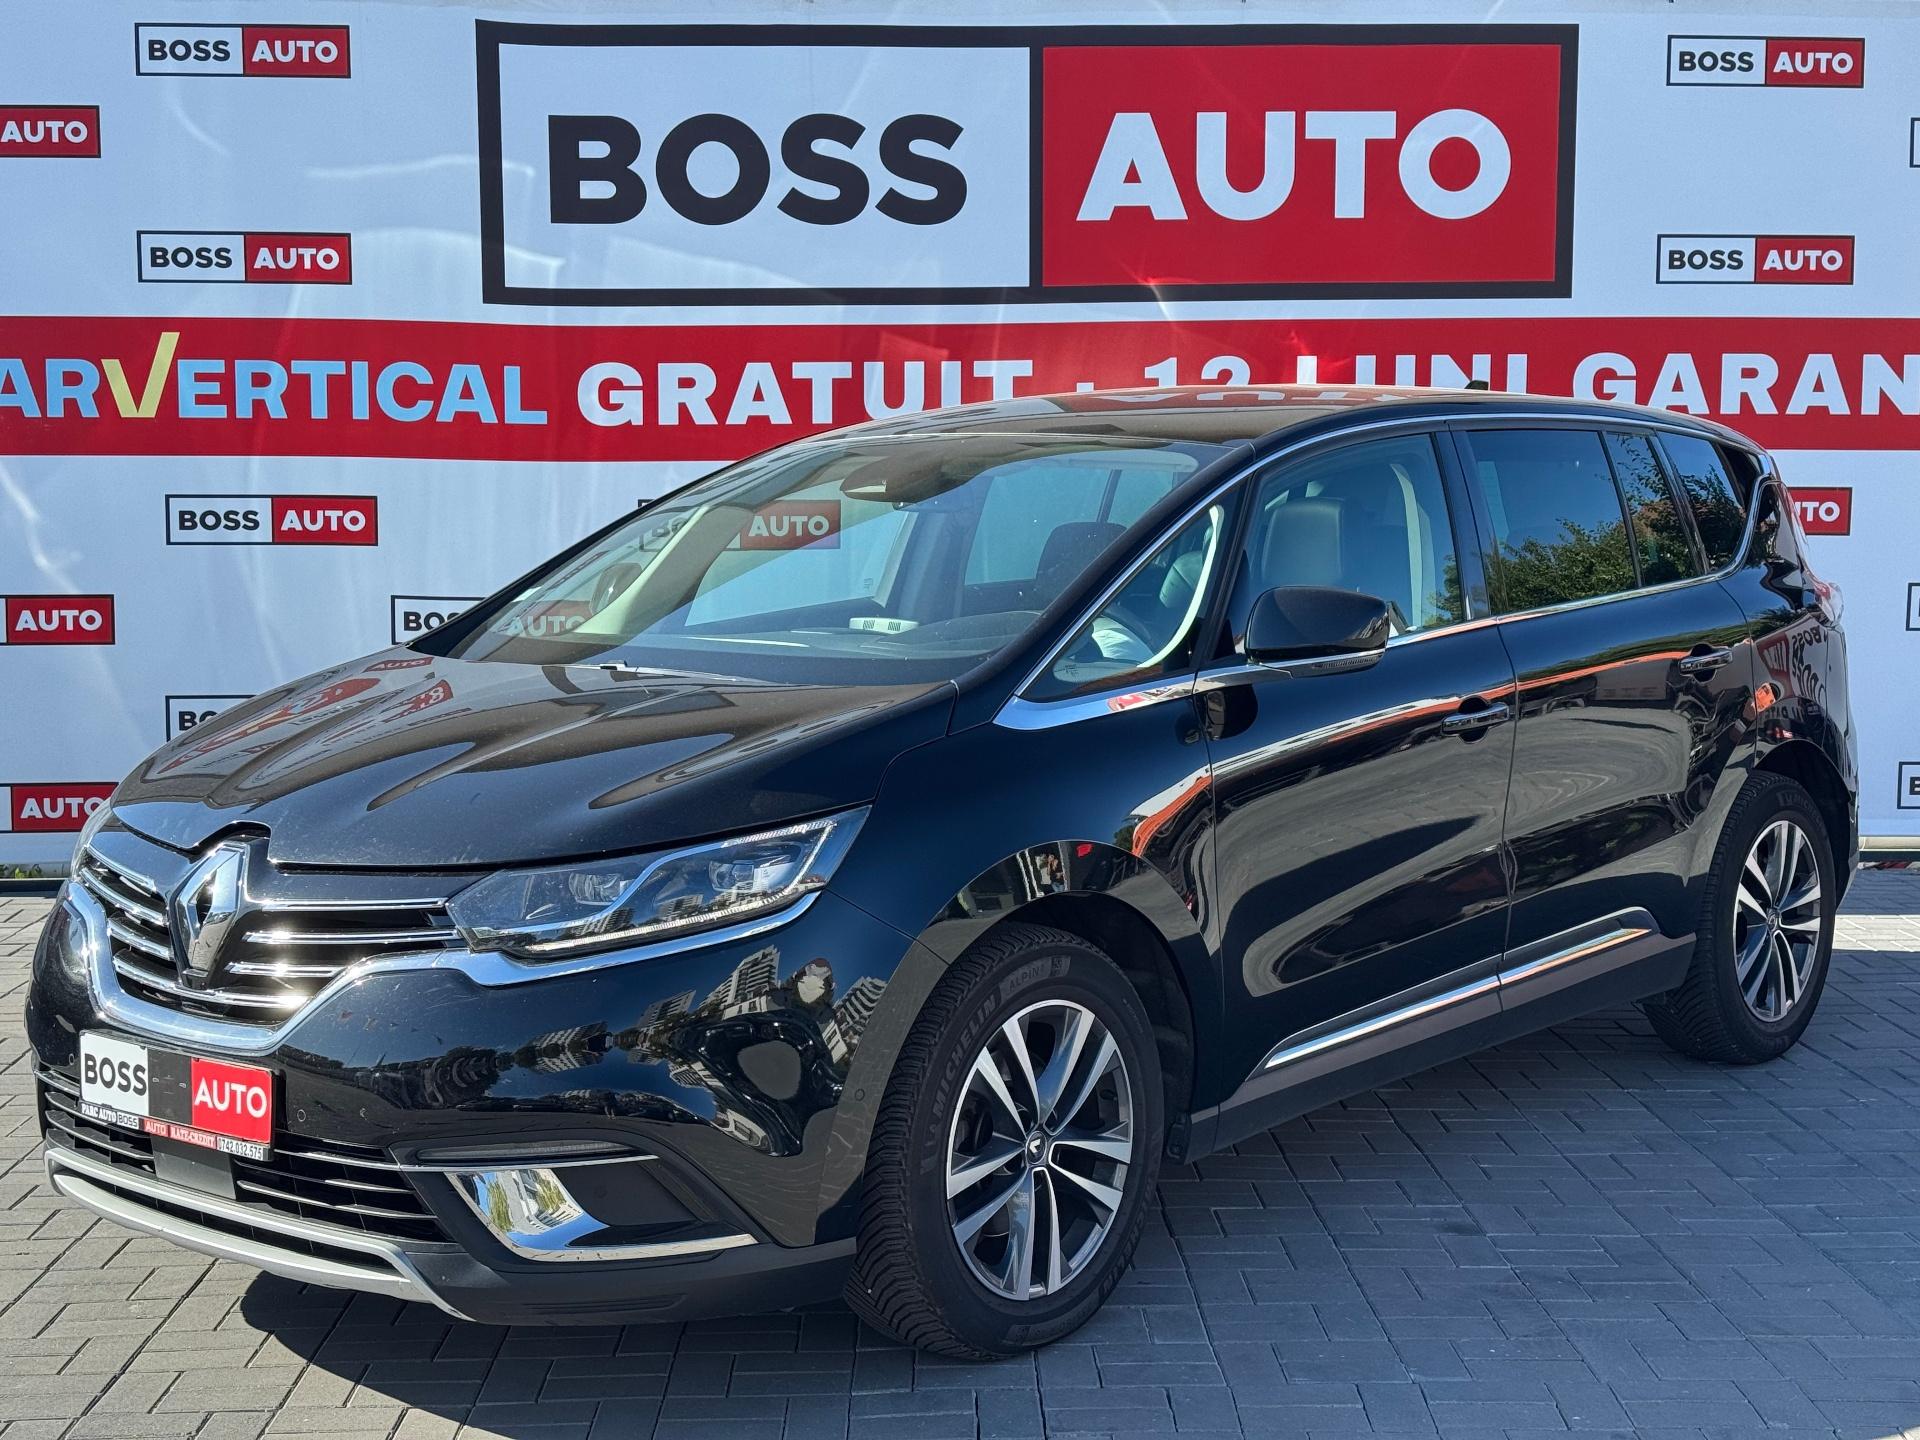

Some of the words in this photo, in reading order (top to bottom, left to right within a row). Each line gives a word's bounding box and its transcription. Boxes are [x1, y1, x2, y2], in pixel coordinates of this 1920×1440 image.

[149, 40, 230, 61] BOSS
[252, 40, 338, 63] AUTO
[1679, 51, 1754, 72] BOSS
[1773, 52, 1853, 73] AUTO
[0, 121, 87, 143] AUTO
[548, 114, 967, 225] BOSS
[1076, 109, 1511, 221] AUTO
[150, 247, 232, 268] BOSS
[254, 248, 339, 270] AUTO
[1669, 250, 1743, 270] BOSS
[1763, 250, 1842, 271] AUTO
[0, 332, 547, 424] ARVERTICAL
[577, 360, 1033, 426] GRATUIT
[1573, 352, 1920, 415] GARAN
[179, 510, 259, 530] BOSS
[281, 510, 365, 531] AUTO
[749, 515, 829, 537] AUTO
[16, 610, 102, 631] AUTO
[404, 611, 460, 631] BO
[21, 797, 104, 818] AUTO
[932, 994, 997, 1118] MICHELIN
[84, 1053, 147, 1096] BOSS
[195, 1077, 268, 1118] AUTO
[81, 1103, 99, 1118] PARC
[98, 1108, 117, 1123] AUTO
[118, 1114, 138, 1128] BOSS
[144, 1121, 167, 1135] AUTO
